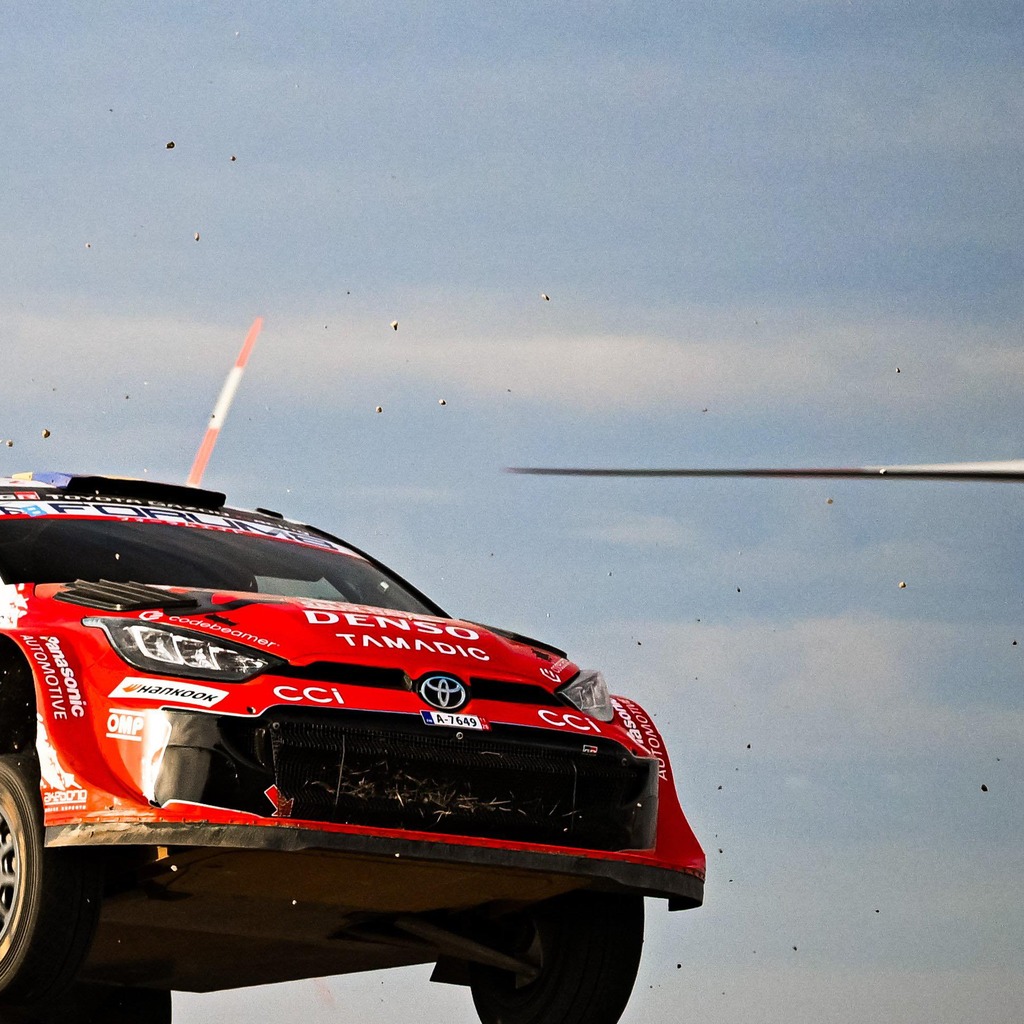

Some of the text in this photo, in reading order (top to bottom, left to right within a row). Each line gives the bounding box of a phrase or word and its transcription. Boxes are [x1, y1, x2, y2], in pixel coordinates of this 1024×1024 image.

[168, 615, 276, 647] codebeamer
[303, 610, 480, 640] DENSO
[336, 633, 490, 661] TAMADIC
[20, 634, 67, 720] AUTOMOTIVE
[106, 713, 144, 736] OMP
[436, 714, 477, 727] A-7649
